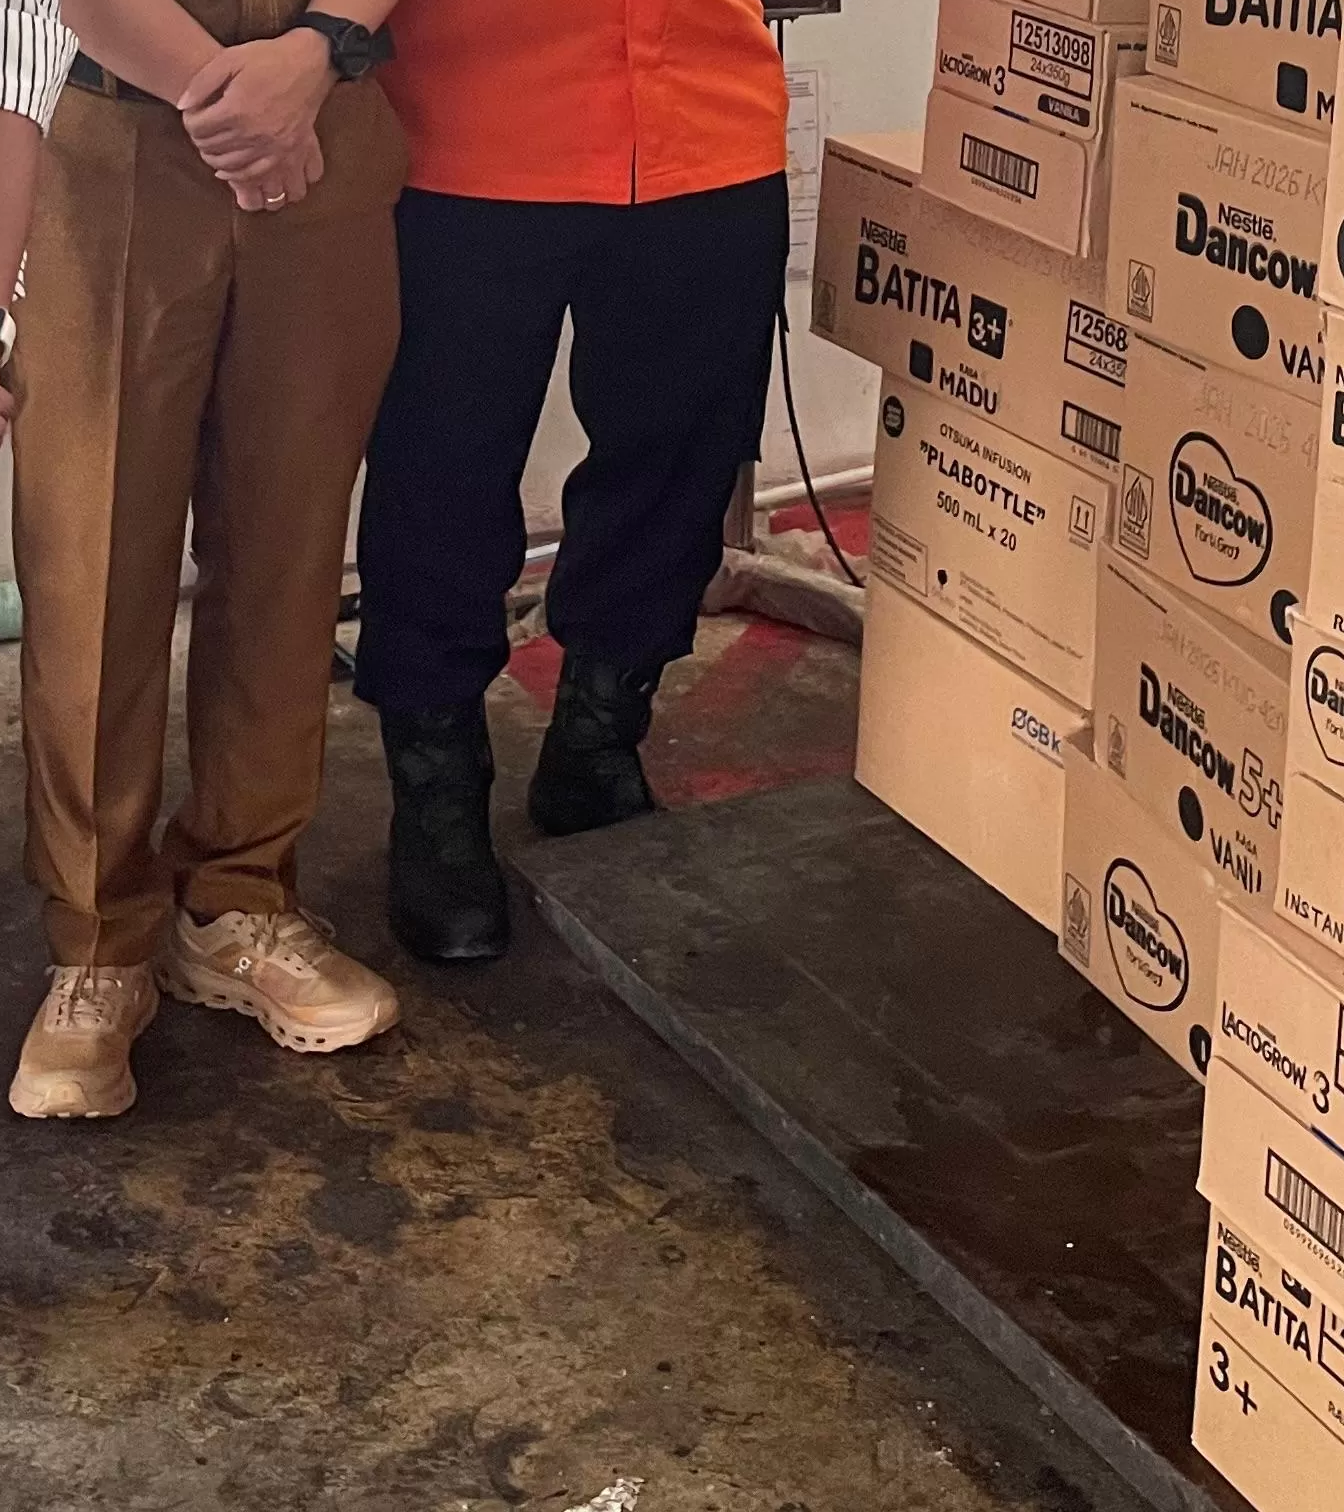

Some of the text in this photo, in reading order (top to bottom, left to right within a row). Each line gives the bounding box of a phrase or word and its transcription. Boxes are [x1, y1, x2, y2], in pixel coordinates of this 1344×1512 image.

[1015, 18, 1091, 68] 12513098
[1029, 56, 1071, 88] 24x350g
[993, 65, 1006, 96] 3
[1174, 191, 1318, 299] Dancow
[854, 243, 962, 329] BATITA
[970, 311, 1003, 342] 3+
[1070, 307, 1129, 353] 12568
[939, 367, 999, 415] MADU
[939, 422, 1032, 485] OTSUKA INFUSION
[936, 490, 1017, 552] 500 mL x 20
[1174, 458, 1266, 549] Dancow
[1138, 660, 1235, 800] Dancow
[1238, 746, 1284, 830] 5+
[1221, 1000, 1330, 1115] LACTOGROW 3
[1215, 1244, 1312, 1364] BATITA
[1209, 1341, 1258, 1417] 3+
